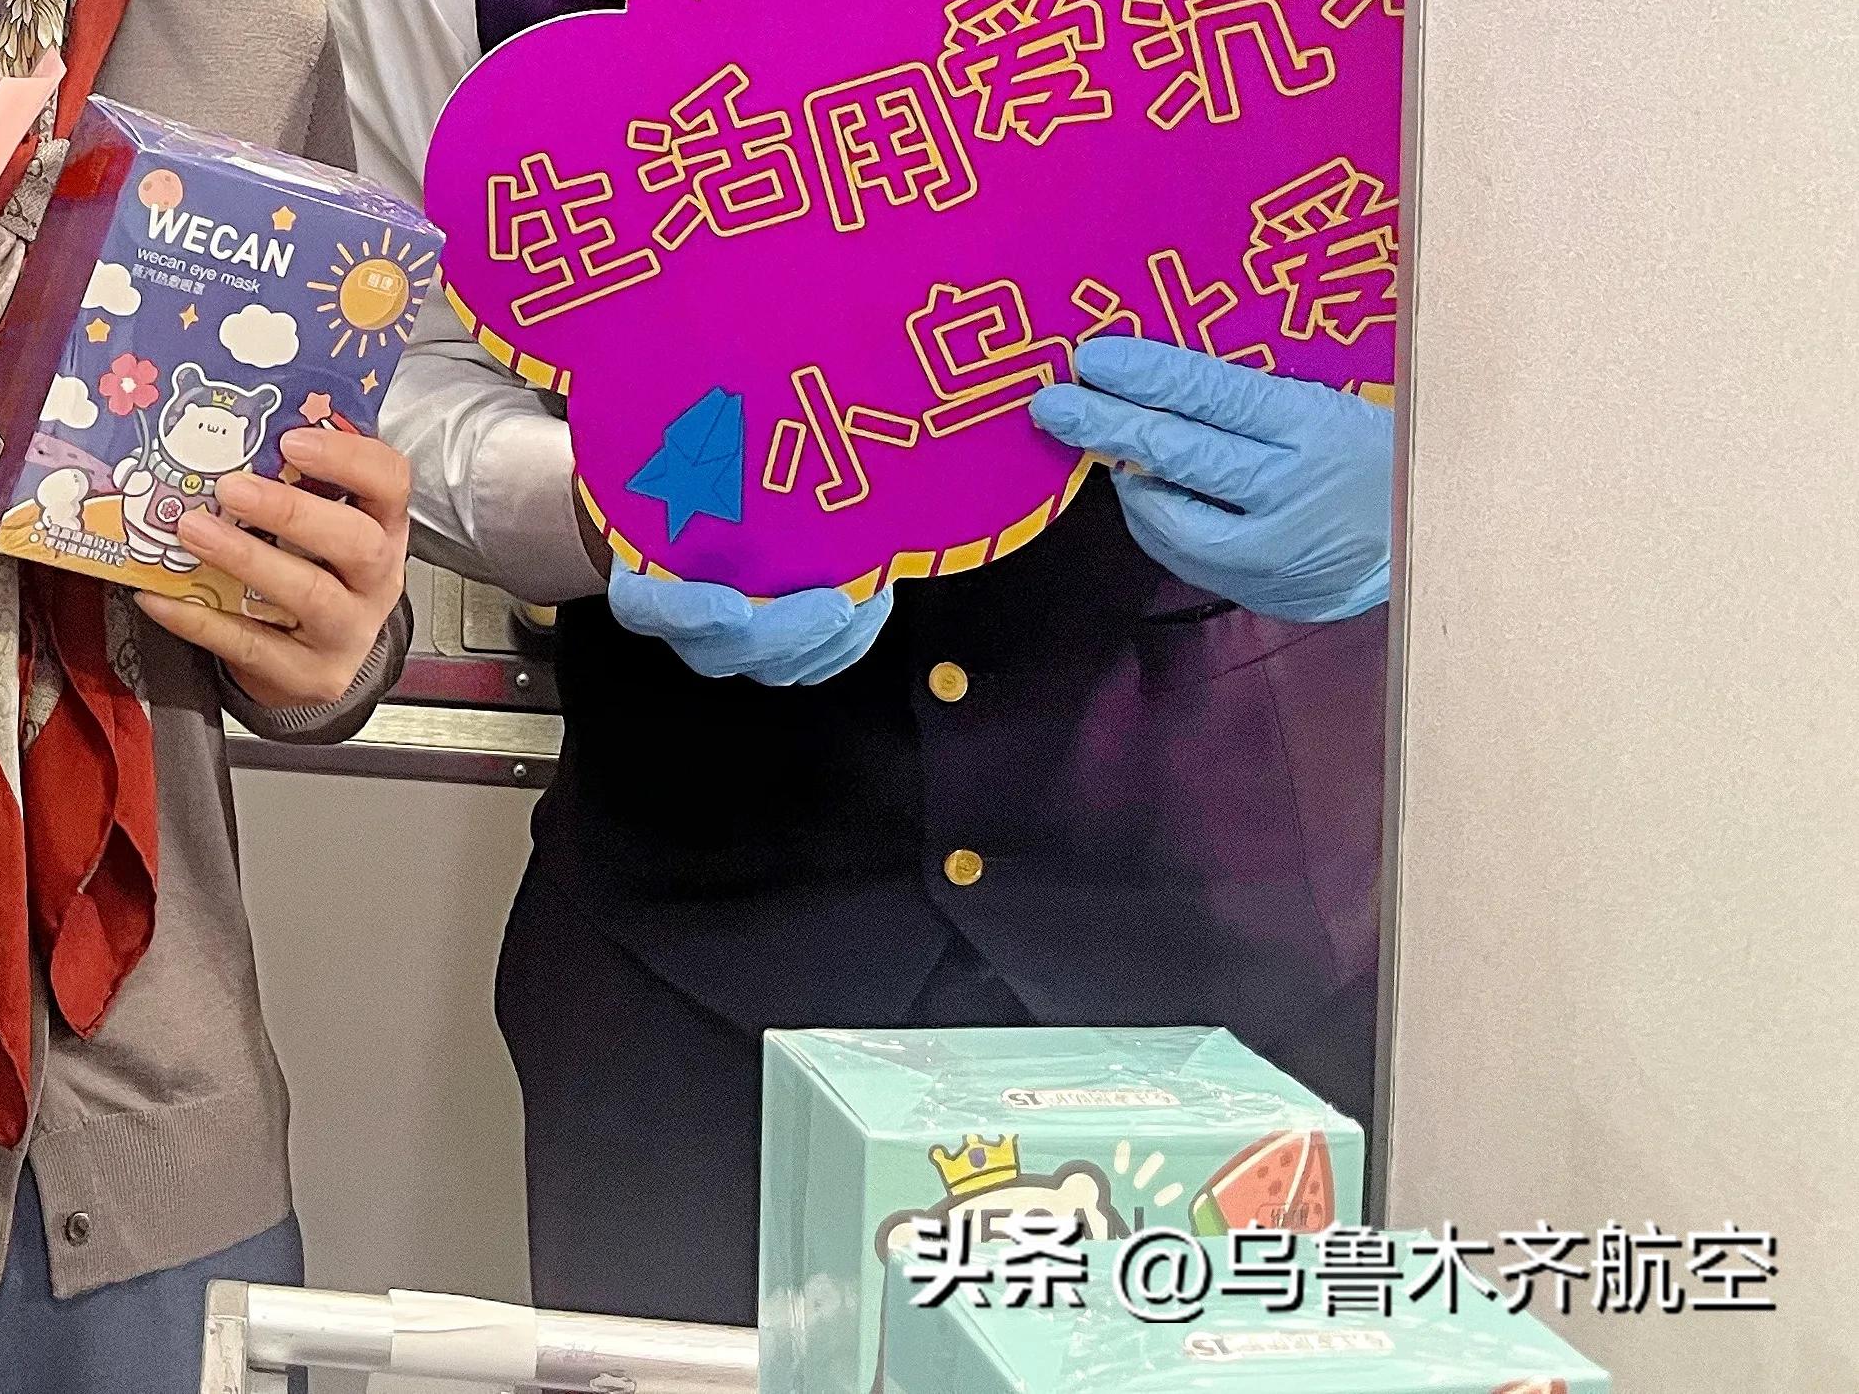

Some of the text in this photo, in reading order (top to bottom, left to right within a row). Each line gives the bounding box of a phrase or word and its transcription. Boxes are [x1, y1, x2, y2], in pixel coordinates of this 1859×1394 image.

[137, 247, 262, 294] wecan eye mask
[148, 203, 296, 278] WECAN
